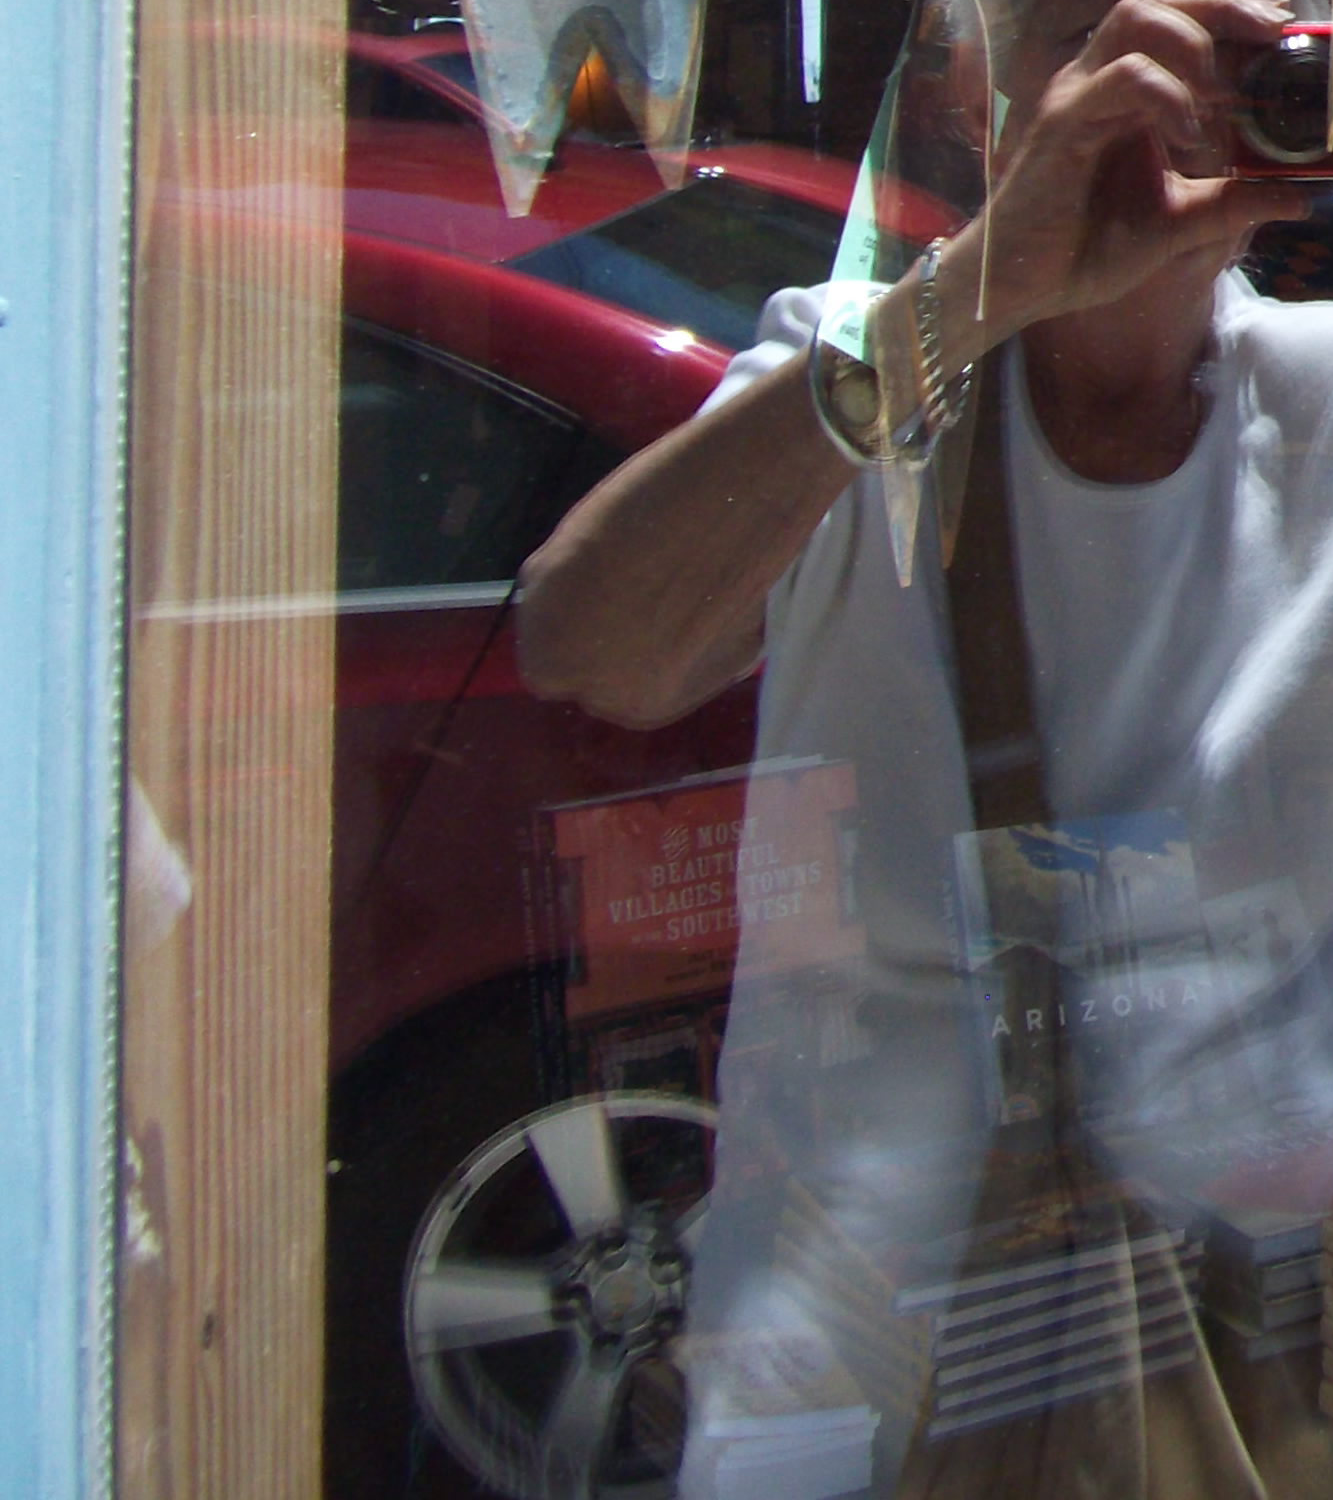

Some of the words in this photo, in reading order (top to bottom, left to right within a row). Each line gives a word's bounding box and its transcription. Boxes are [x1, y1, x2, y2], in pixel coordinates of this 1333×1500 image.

[696, 817, 759, 847] MOST
[650, 844, 780, 888] BEAUTIFUL
[606, 881, 723, 925] VILLAGES
[748, 861, 823, 896] TOWNS
[666, 893, 802, 941] SOUTHWEST
[991, 984, 1199, 1039] ARIZONA
